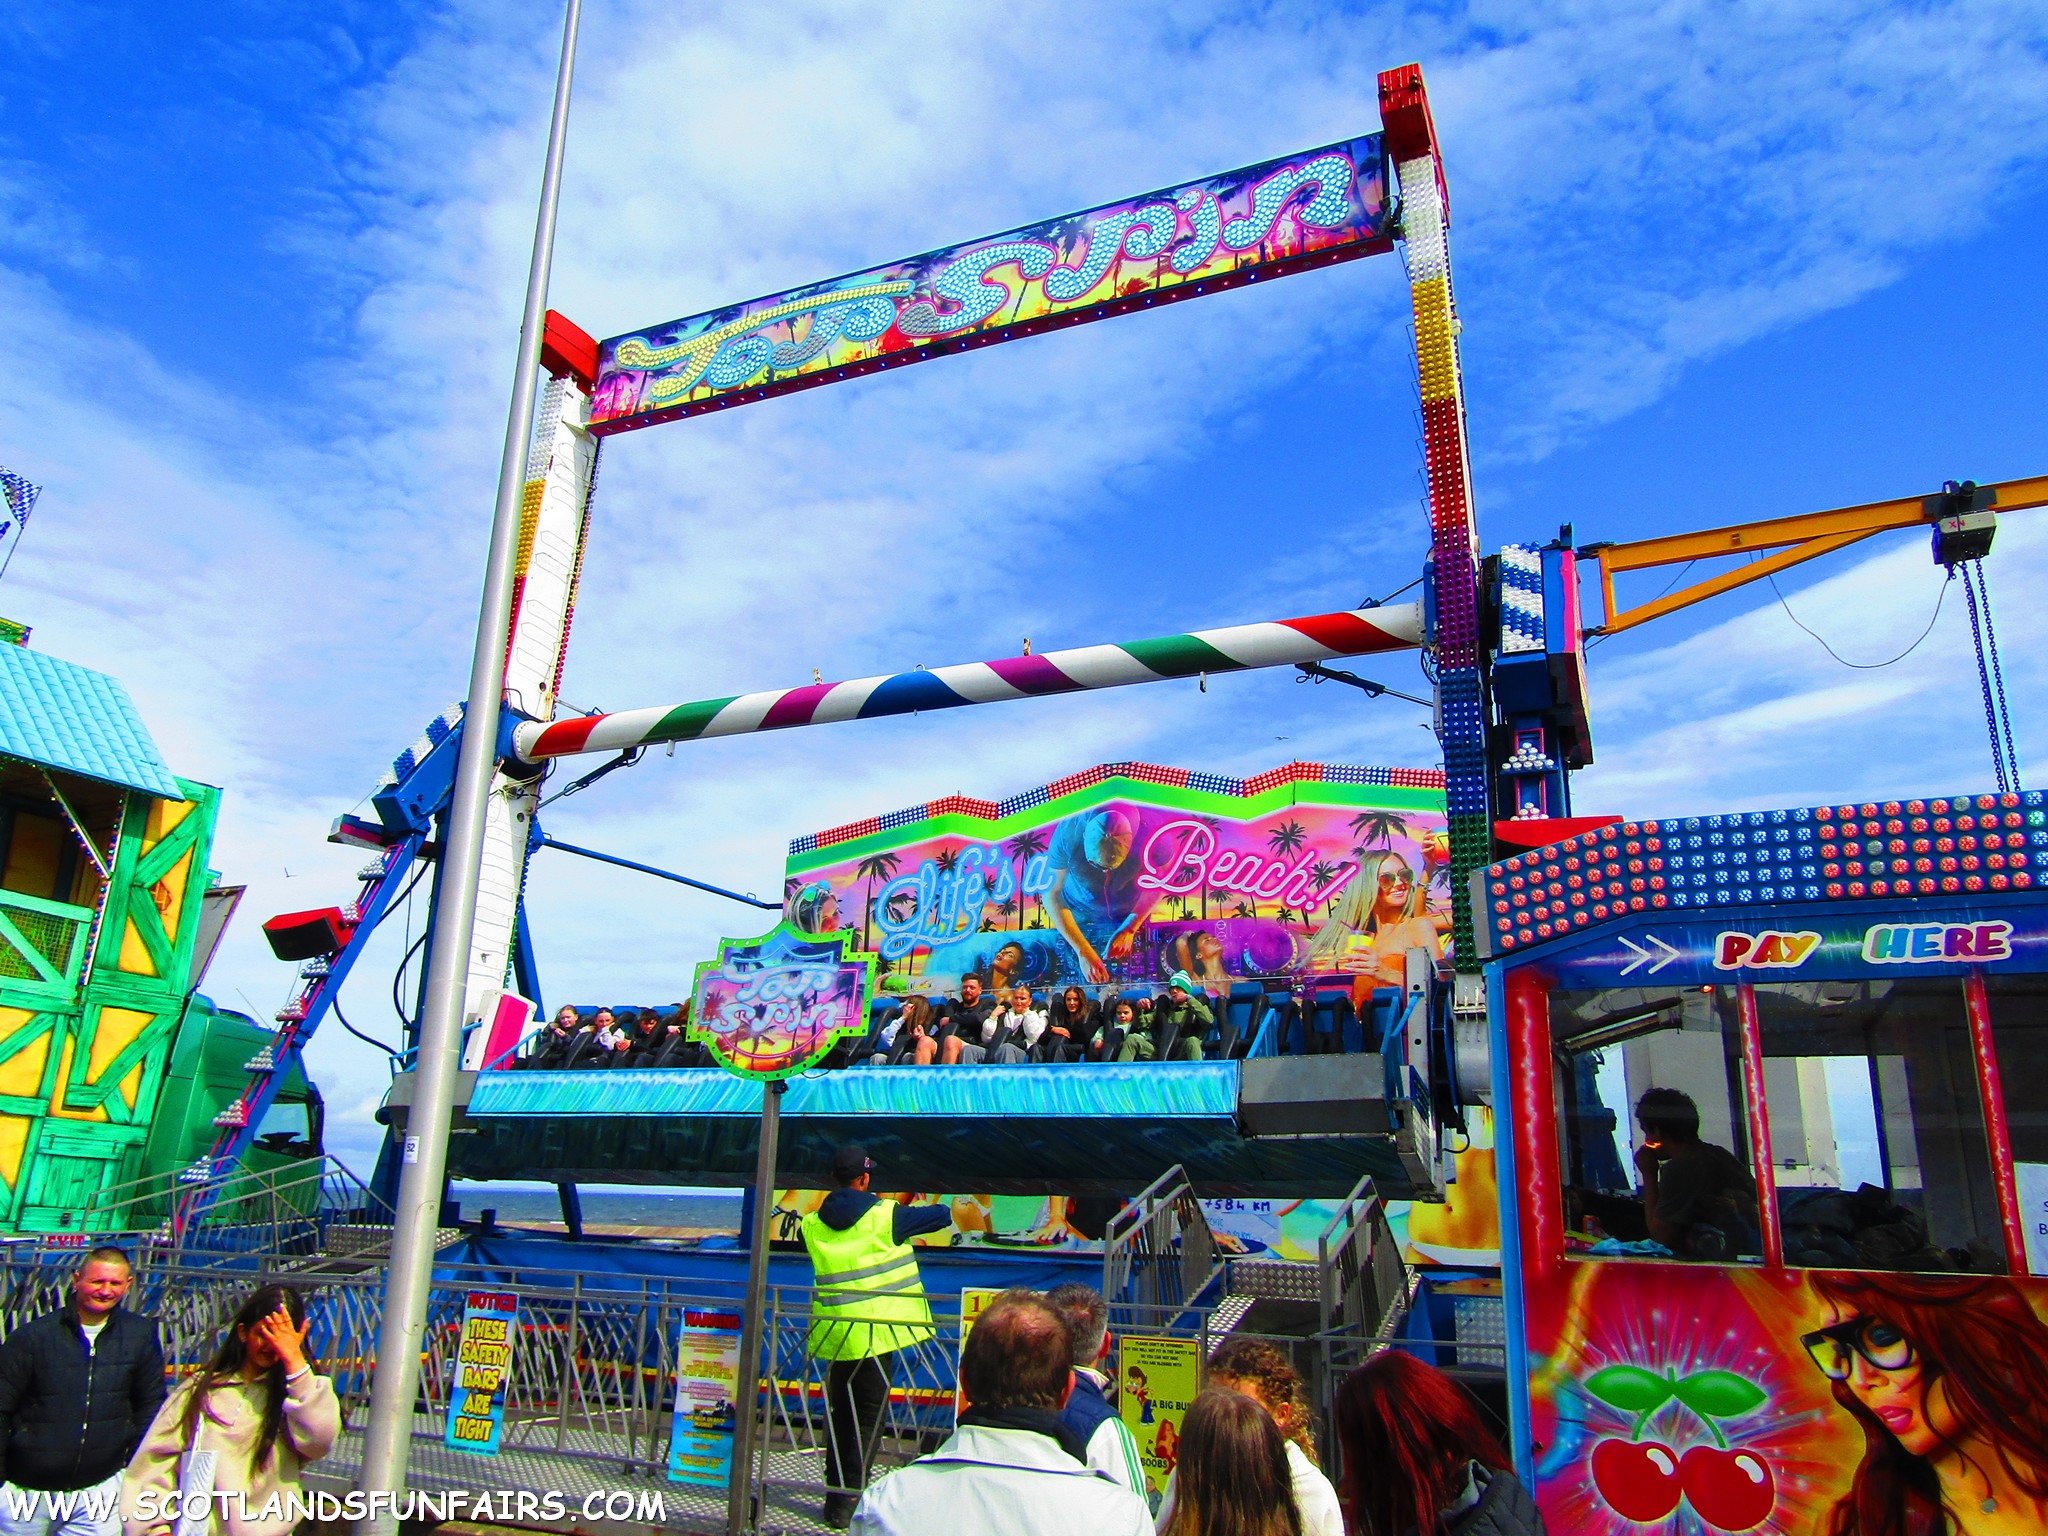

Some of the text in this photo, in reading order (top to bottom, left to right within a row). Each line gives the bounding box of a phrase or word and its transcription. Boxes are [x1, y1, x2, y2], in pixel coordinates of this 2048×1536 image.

[1021, 852, 1057, 894] a
[1136, 819, 1358, 911] Beach!
[1717, 924, 2010, 967] PAY HERE
[467, 1292, 518, 1312] NOTICE
[469, 1317, 508, 1341] THESE
[685, 1311, 741, 1330] WARNING
[460, 1341, 511, 1367] SAFETY
[462, 1366, 501, 1392] BARS
[461, 1391, 493, 1416] ARE
[1151, 1400, 1158, 1408] A
[1159, 1400, 1174, 1410] BIG
[454, 1416, 495, 1442] TIGHT
[1140, 1457, 1168, 1468] BOOBS
